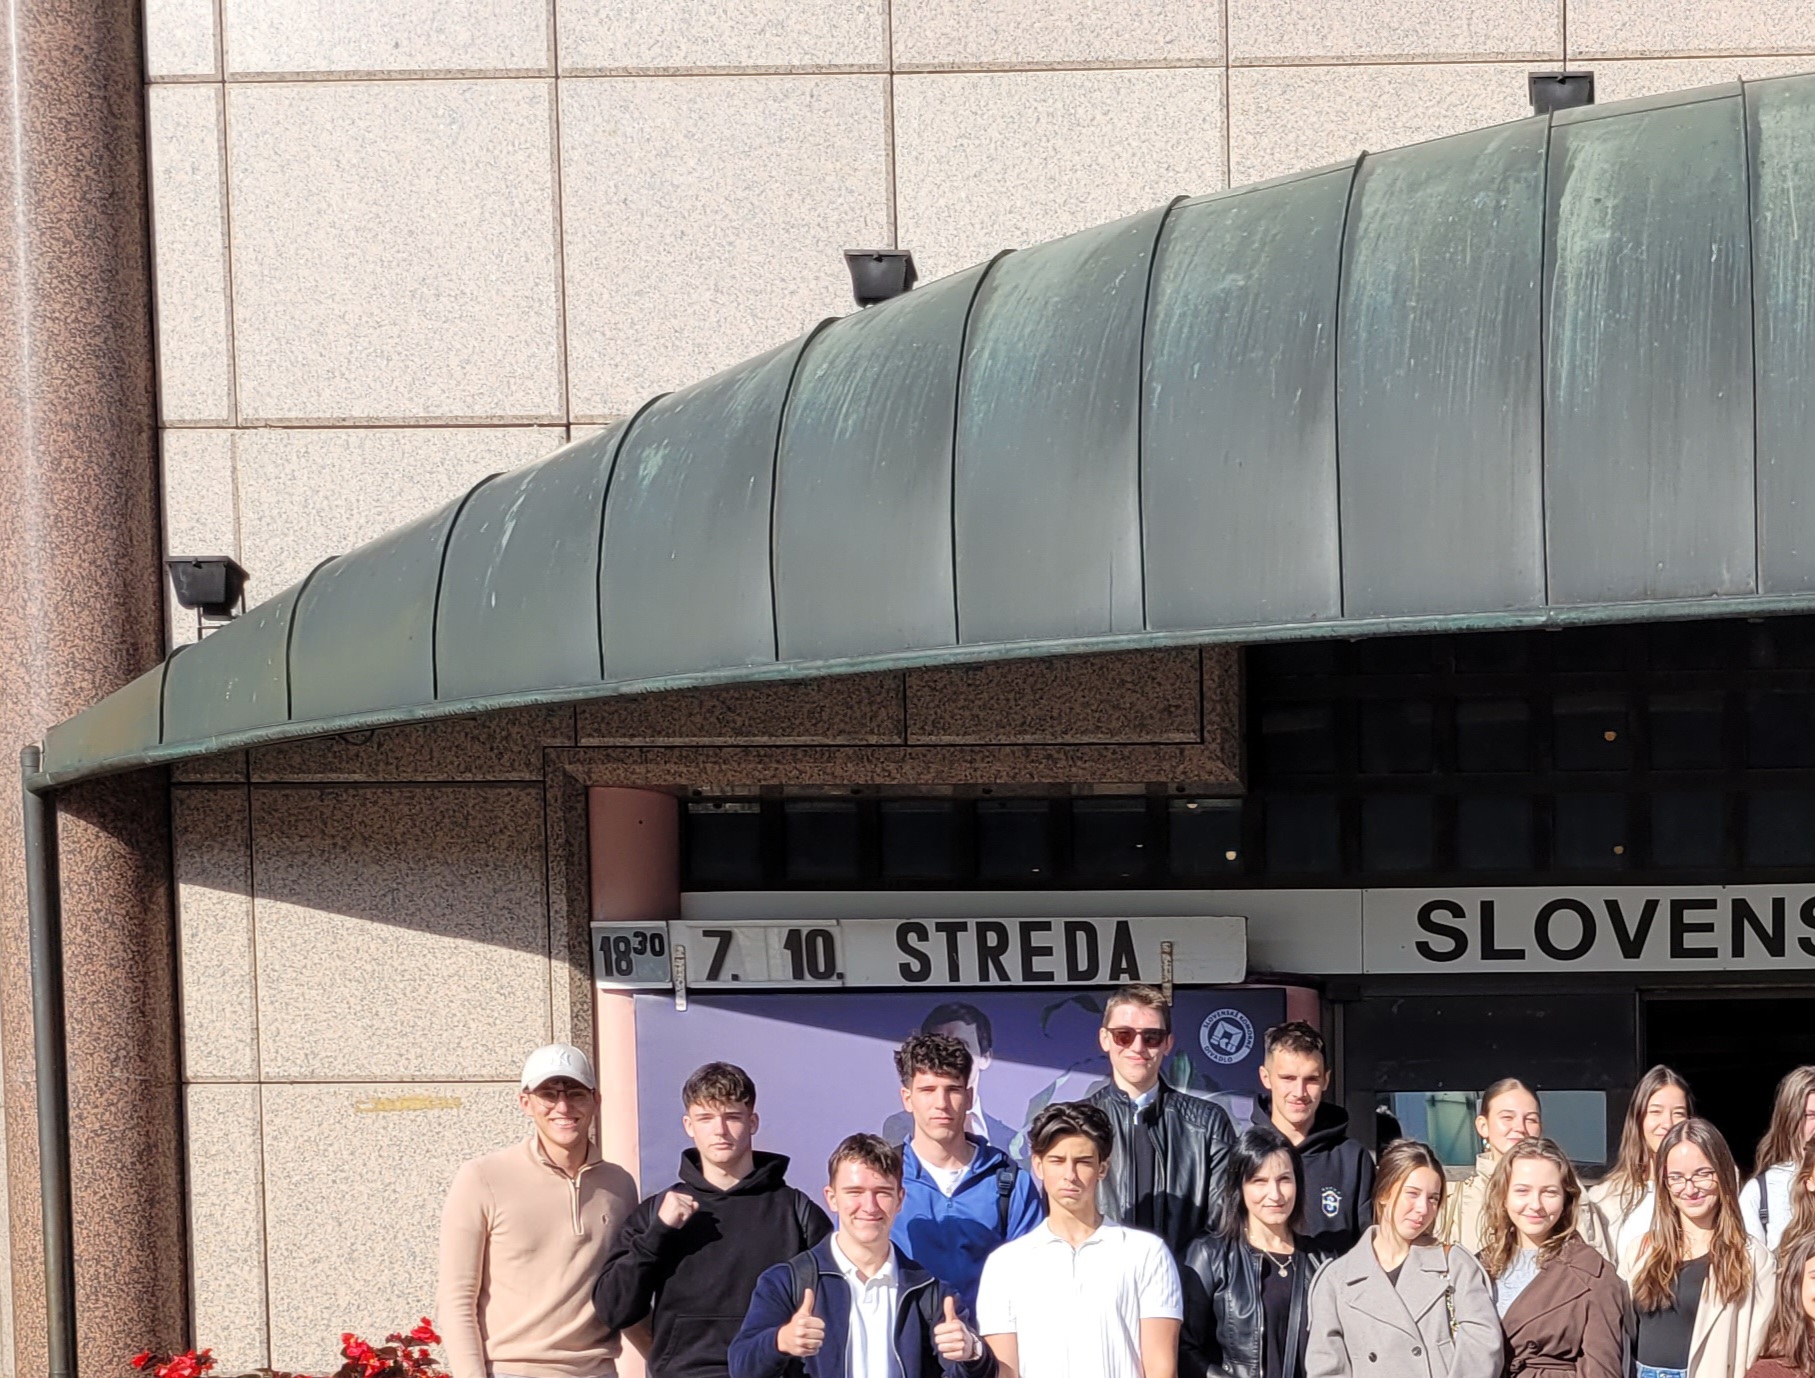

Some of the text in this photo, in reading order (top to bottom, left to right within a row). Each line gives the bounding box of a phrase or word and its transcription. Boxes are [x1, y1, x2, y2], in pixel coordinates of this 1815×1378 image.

[702, 929, 740, 981] 7.
[783, 928, 844, 981] 10.
[896, 920, 1141, 982] STREDA
